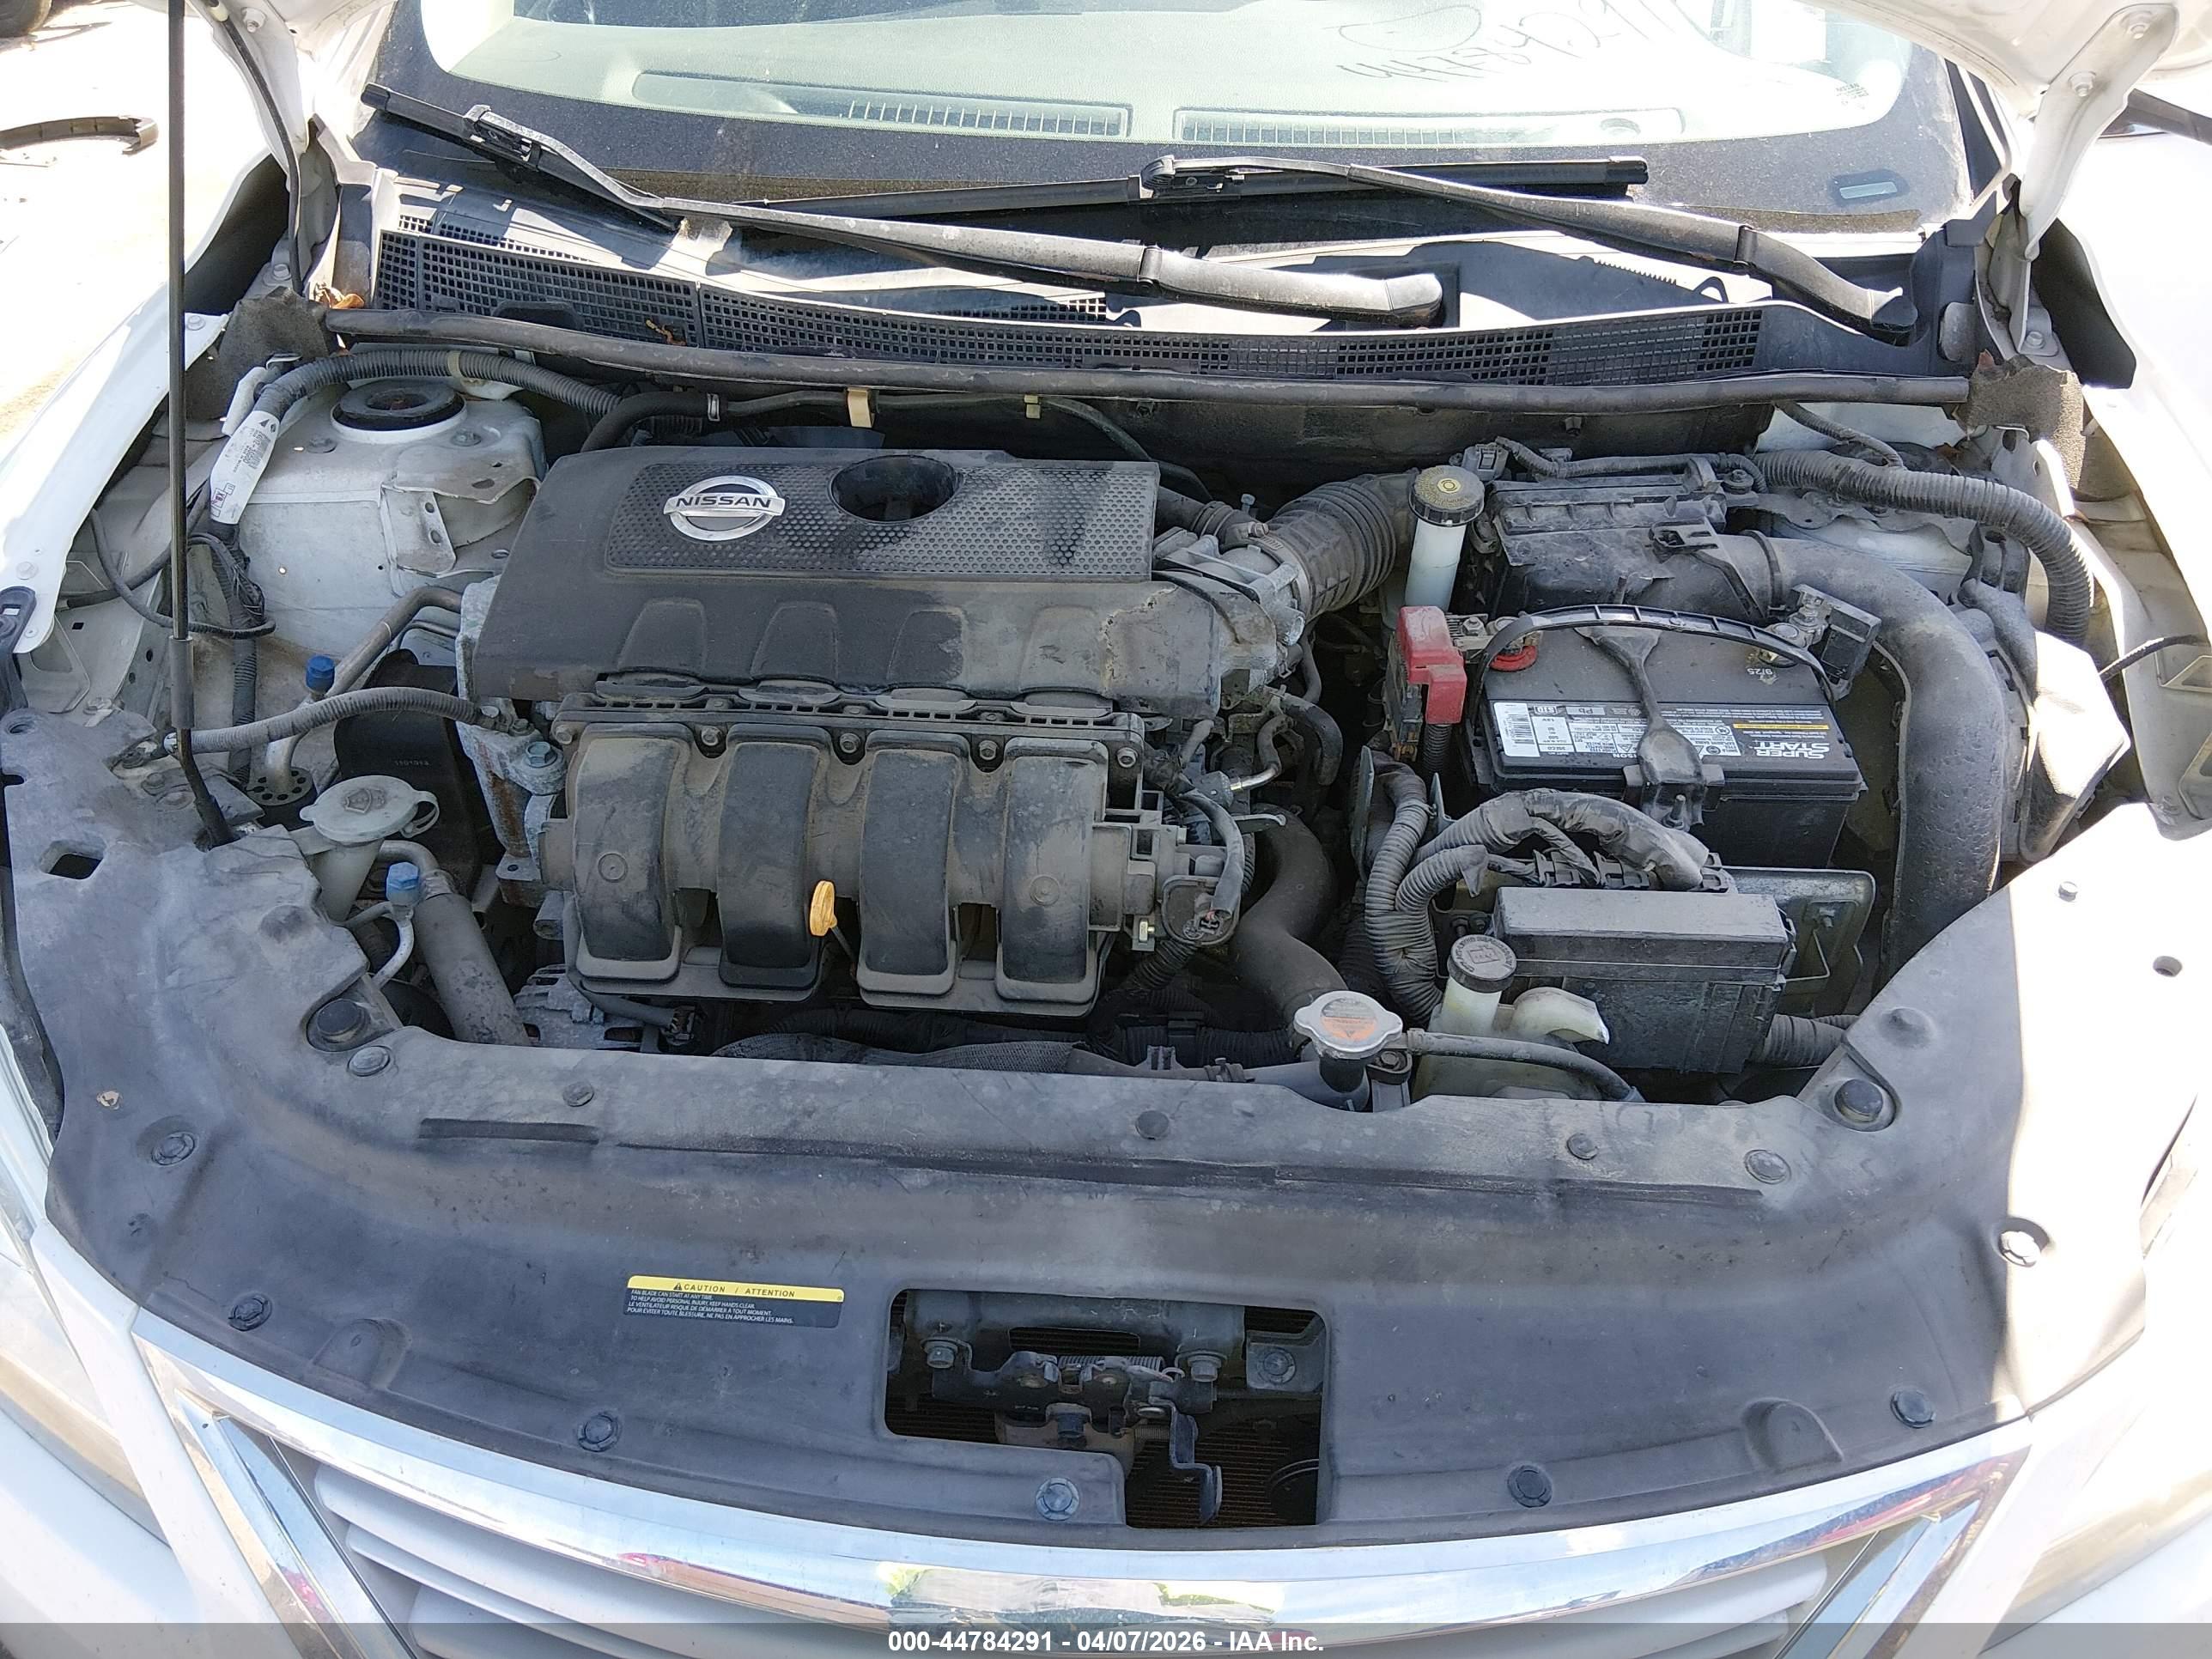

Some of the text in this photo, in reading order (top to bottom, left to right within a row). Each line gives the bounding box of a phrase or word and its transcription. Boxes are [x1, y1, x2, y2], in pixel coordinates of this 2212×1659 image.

[676, 495, 772, 508] NISSAN
[1753, 742, 1830, 752] START
[1756, 749, 1825, 759] SUPER
[684, 1283, 726, 1293] CAUTION
[745, 1288, 796, 1297] ATTENTION
